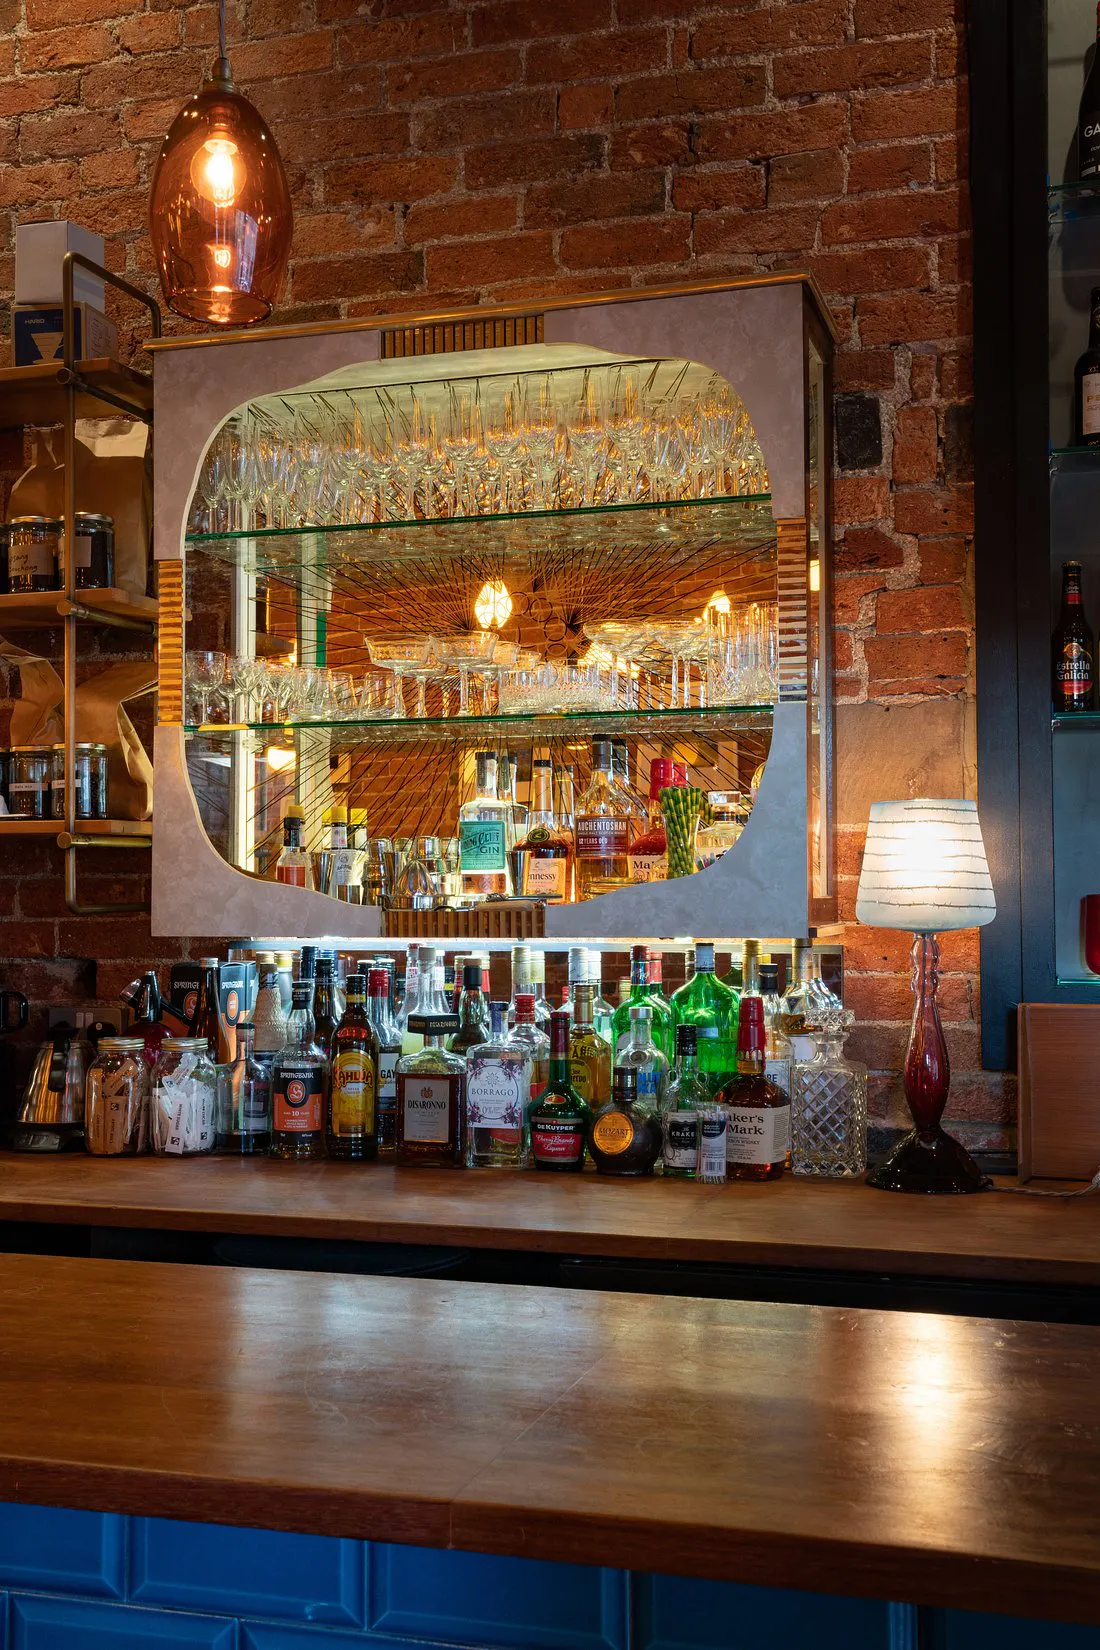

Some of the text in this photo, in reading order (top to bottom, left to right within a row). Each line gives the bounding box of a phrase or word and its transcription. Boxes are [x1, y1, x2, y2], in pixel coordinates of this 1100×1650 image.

[1056, 661, 1090, 670] Estrella
[1057, 670, 1089, 680] Galicia
[577, 821, 627, 831] AUCHENTOSHAN
[479, 846, 500, 854] GIN
[528, 873, 557, 882] nnessy
[173, 981, 200, 989] SPRING
[471, 1088, 515, 1097] BORRAGO
[407, 1100, 447, 1111] DISARONNO
[728, 1113, 764, 1123] aker's
